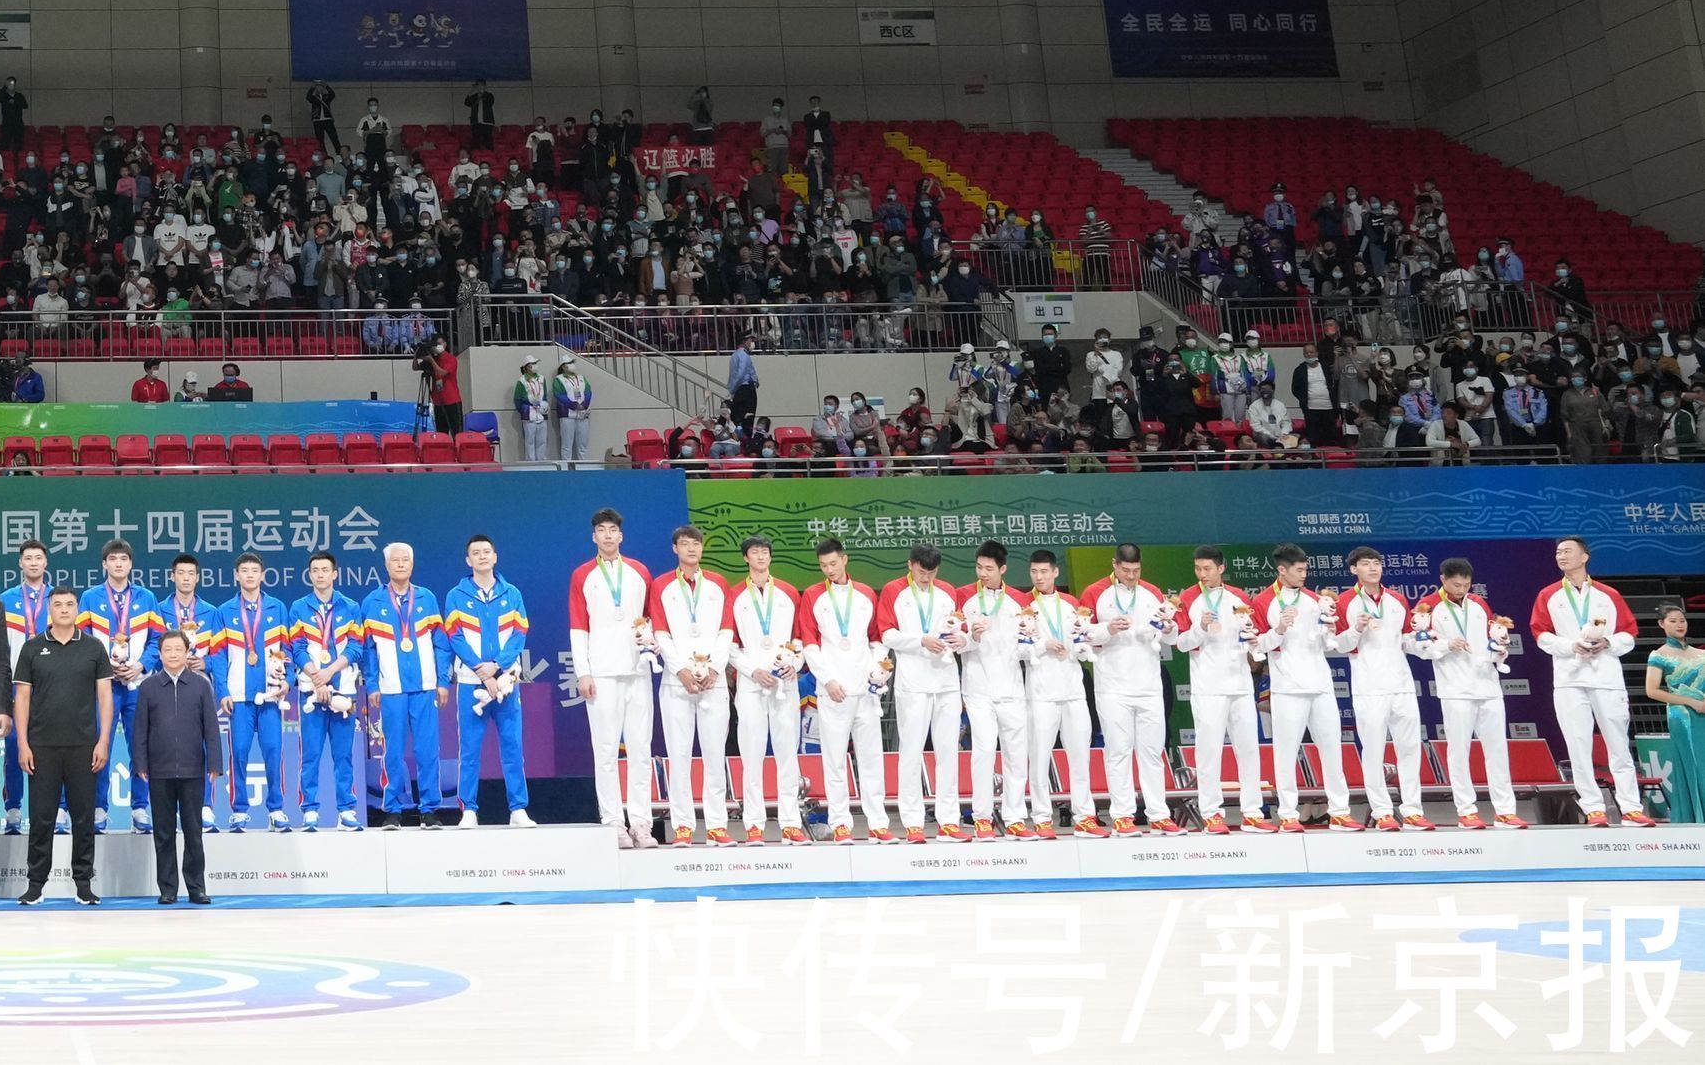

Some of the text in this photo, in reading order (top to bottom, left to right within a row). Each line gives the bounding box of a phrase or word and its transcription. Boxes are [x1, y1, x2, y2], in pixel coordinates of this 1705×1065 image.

[1120, 12, 1318, 32] 全民全运 同心同行
[880, 25, 916, 38] 西C区
[643, 147, 716, 170] 辽篮必胜
[1035, 305, 1063, 317] 出口
[1297, 513, 1370, 524] 中国陕西 2021
[806, 511, 1115, 537] 中华人民共和国第十四届运动会
[1629, 524, 1651, 534] THE
[1673, 524, 1705, 534] GAME
[1298, 525, 1372, 535] SHAANXI CHINA
[855, 538, 897, 548] GAMES
[900, 538, 916, 547] OF
[1002, 535, 1059, 545] REPUBLIC
[1061, 534, 1076, 544] OF
[1079, 534, 1117, 544] CHINA
[1232, 553, 1429, 571] 中华人和国第届运动会
[263, 567, 295, 588] OF
[301, 566, 382, 587] CINA
[1406, 568, 1430, 576] CHINA
[1399, 848, 1417, 857] 2021
[1421, 848, 1446, 856] CHINA
[1447, 848, 1483, 856] SHAANXI
[1612, 843, 1631, 852] 2021
[1635, 843, 1660, 851] CHINA
[1661, 843, 1701, 851] SHAANXI
[1161, 852, 1179, 861] 2021
[1183, 852, 1208, 860] CHINA
[1209, 851, 1248, 859] SHAANXI
[705, 863, 723, 872] 2021
[727, 863, 753, 871] CHINA
[754, 863, 793, 871] SHAANXI
[942, 859, 961, 868] 2021
[965, 859, 990, 867] CHINA
[991, 858, 1028, 866] SHAANXI
[240, 871, 259, 880] 2021
[290, 871, 329, 879] SHAANXI
[479, 869, 497, 878] 2021
[501, 869, 527, 877] CHINA
[528, 868, 566, 877] SHAANXI
